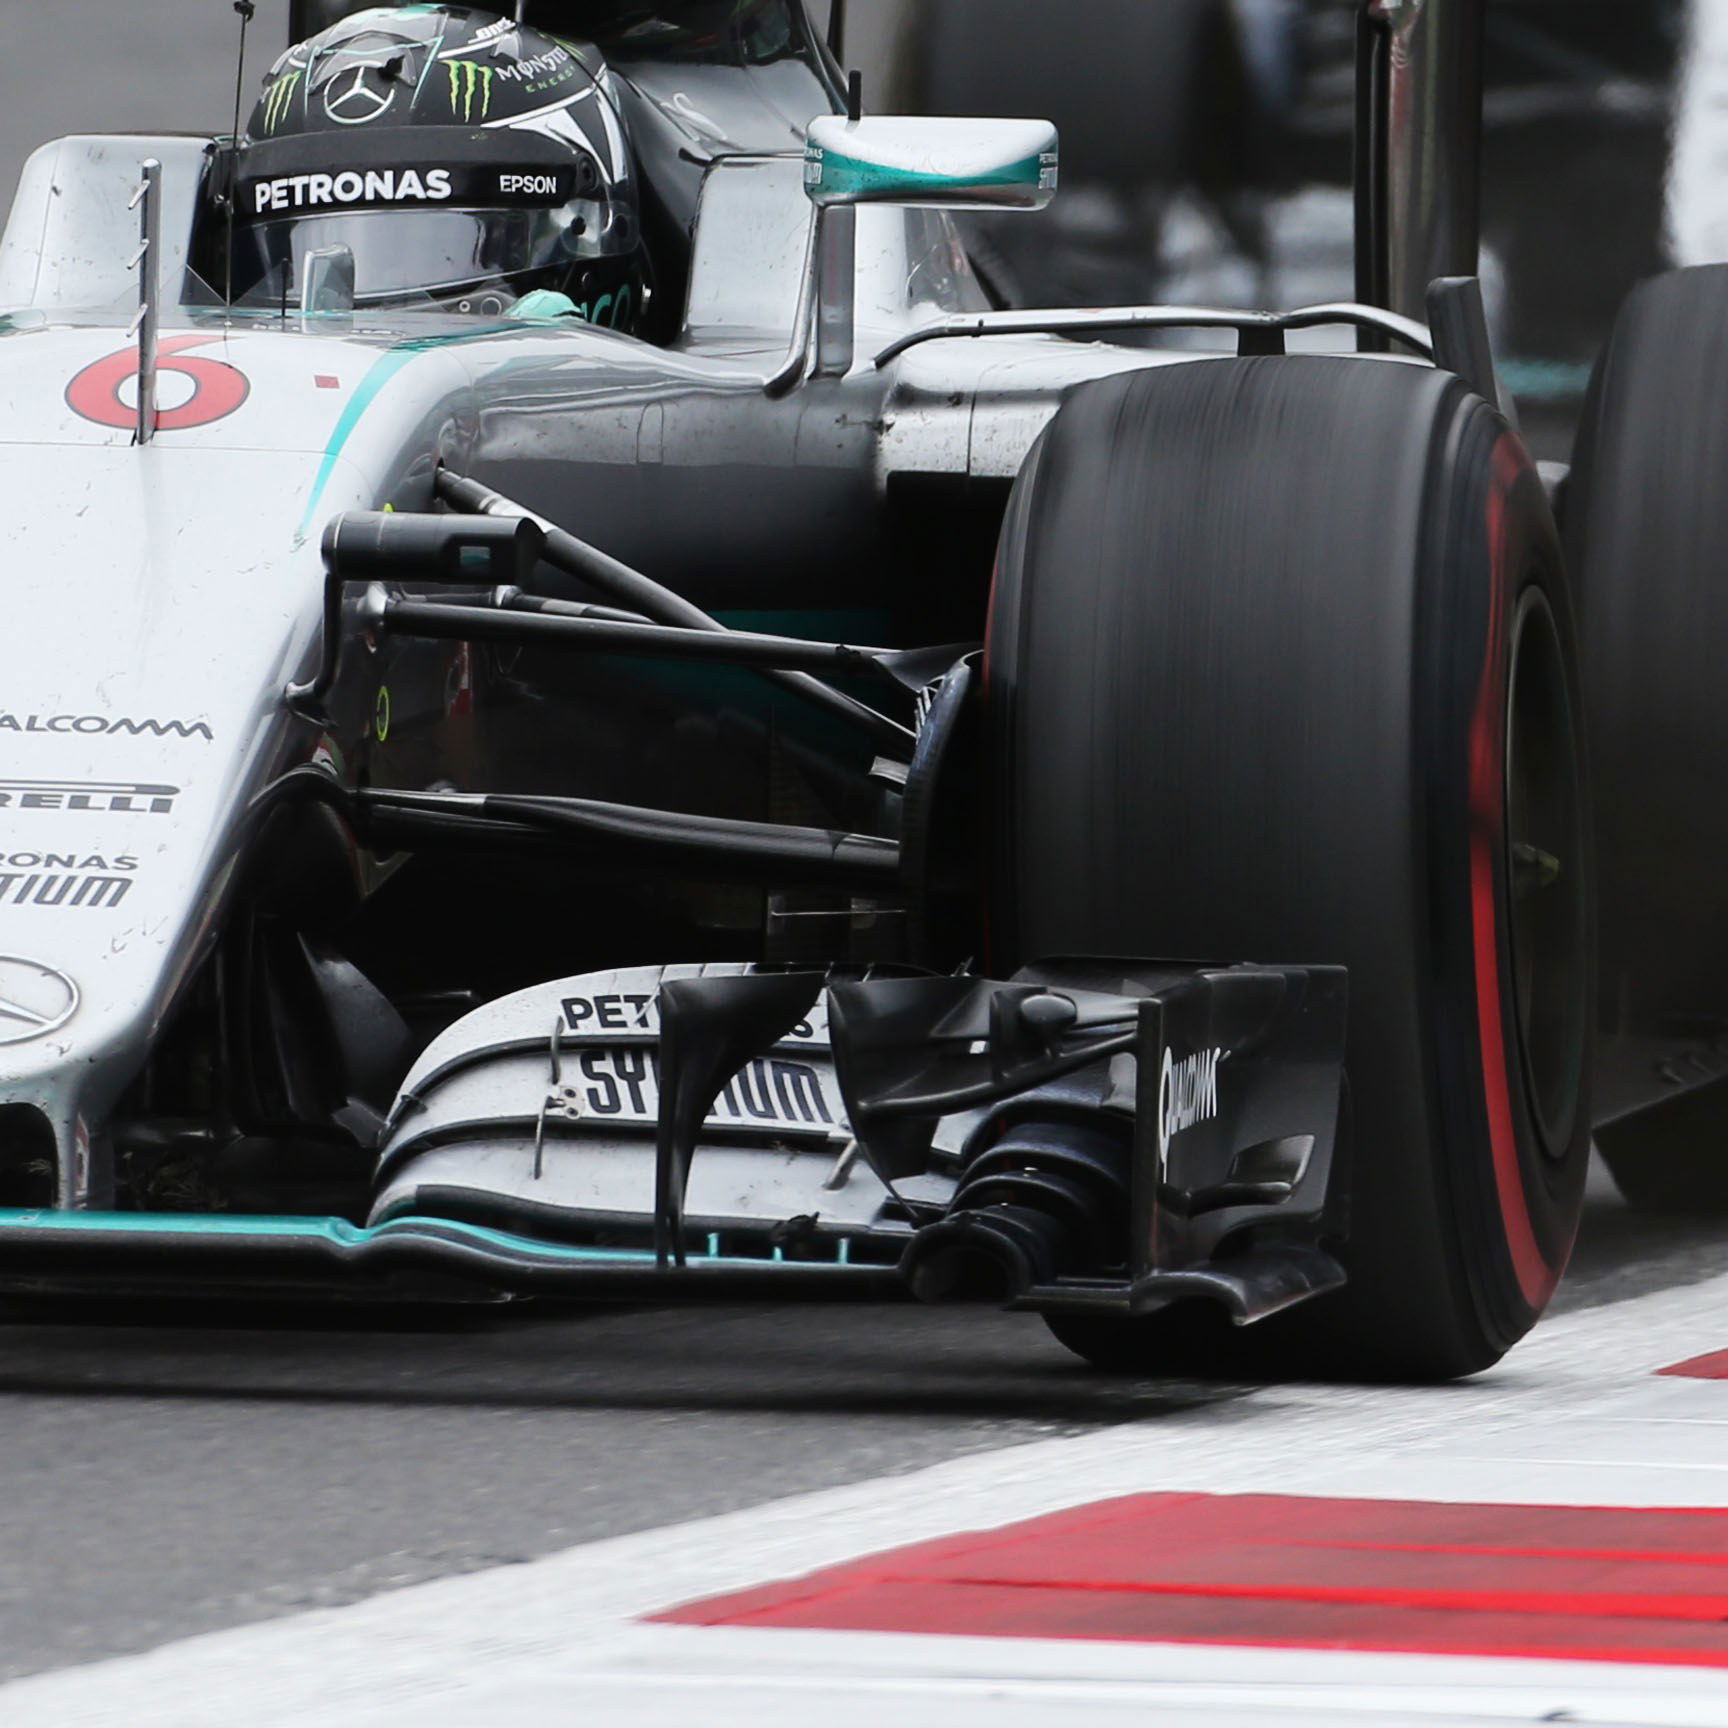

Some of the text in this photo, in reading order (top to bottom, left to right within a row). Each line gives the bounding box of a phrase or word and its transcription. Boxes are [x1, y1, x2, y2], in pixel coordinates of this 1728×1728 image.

[494, 45, 570, 82] MONST
[254, 169, 557, 213] PETRONAS EPSON
[64, 334, 251, 431] 6
[579, 1049, 834, 1124] SYIUM
